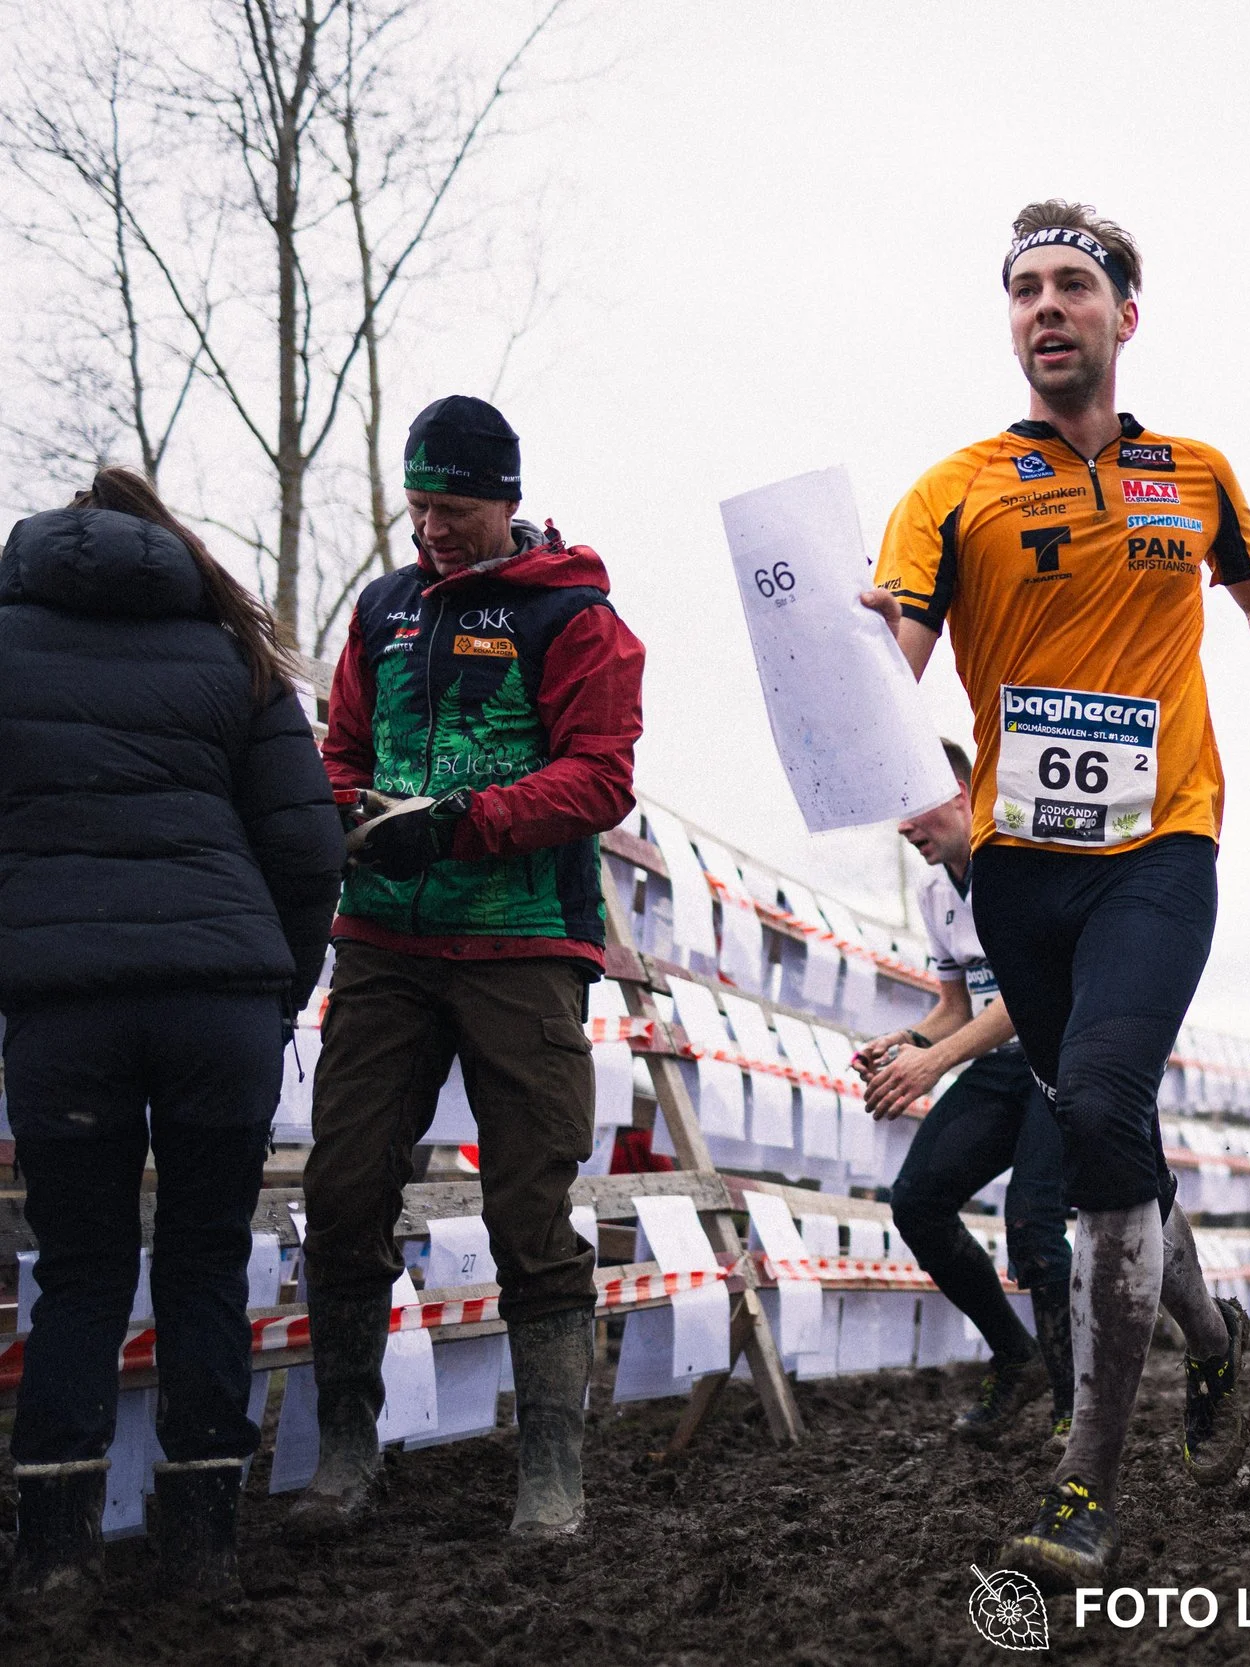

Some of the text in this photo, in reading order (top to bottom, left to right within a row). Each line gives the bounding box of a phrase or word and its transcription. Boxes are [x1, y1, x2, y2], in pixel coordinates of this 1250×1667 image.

[1122, 448, 1170, 462] sport
[1000, 486, 1086, 508] Sparbanken
[1122, 480, 1178, 498] MAXI
[1021, 502, 1066, 518] Skåne
[1128, 515, 1203, 532] STRANDVILLAN
[1128, 537, 1192, 560] PAN-
[755, 561, 796, 598] 66
[460, 608, 514, 633] OKK
[474, 639, 514, 650] BOLIST
[1005, 691, 1155, 728] bagheera
[1018, 723, 1086, 738] KOLMÅRDSKAVLEN
[1094, 732, 1108, 740] STL
[1120, 734, 1138, 743] 2026
[1039, 746, 1148, 794] 66 2
[1040, 805, 1098, 818] GODKÄNDA
[462, 1254, 477, 1272] 27
